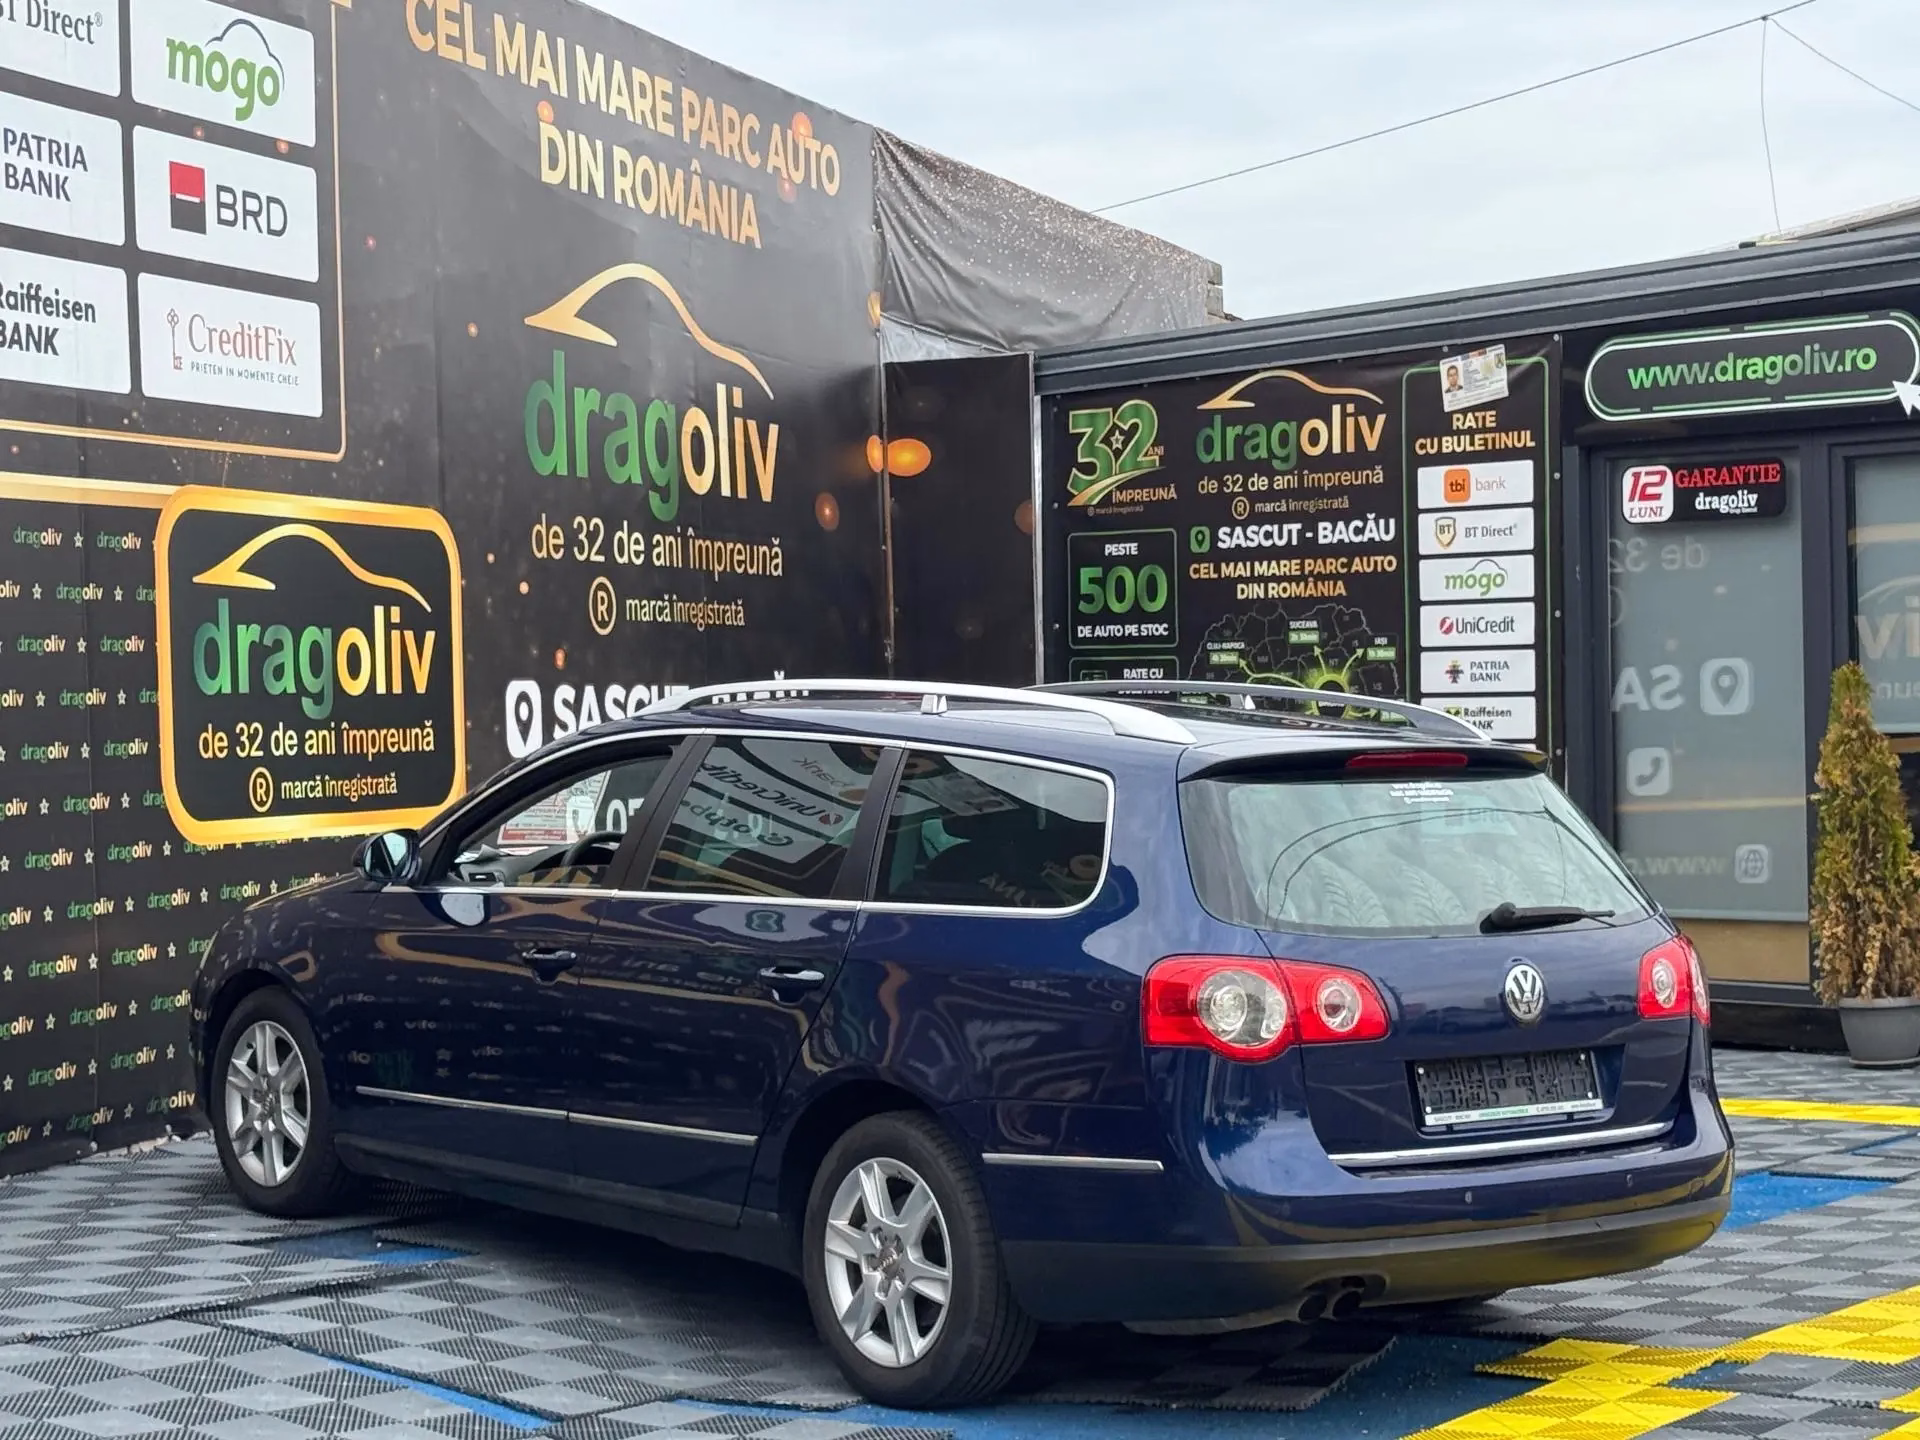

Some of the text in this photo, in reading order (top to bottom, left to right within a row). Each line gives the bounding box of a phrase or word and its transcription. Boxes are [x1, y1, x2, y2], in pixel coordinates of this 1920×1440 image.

[166, 37, 280, 121] mogo
[405, 0, 841, 197] CEL MAI MARE PARC AUTO
[3, 126, 88, 172] PATRIA
[5, 161, 71, 202] BANK
[538, 120, 763, 250] DIN ROMÂNIA
[216, 184, 288, 238] BRD
[188, 313, 297, 366] CreditFix
[191, 361, 299, 386] PRIETEN IN MOMENTE CHEIE
[1627, 343, 1877, 390] www.dragoliv.ro
[1452, 410, 1496, 430] RATE
[524, 350, 780, 522] dragoliv
[1066, 398, 1159, 496] 32
[1195, 403, 1387, 471] dragoliv
[1414, 430, 1536, 455] CU BULETINUL
[1198, 465, 1384, 494] de 32 de ani împreună
[1449, 476, 1507, 492] tbi bank
[1628, 470, 1667, 503] 12
[1675, 463, 1781, 488] GARANTIE
[1255, 499, 1287, 513] marcă
[1288, 495, 1349, 513] înregistrată
[1629, 506, 1663, 519] LUNI
[1695, 489, 1758, 514] dragoliv
[13, 526, 142, 552] dragoliv dragoliv
[1217, 522, 1302, 549] SASCUT
[1318, 512, 1396, 544] BACĂU
[1464, 526, 1479, 538] BT
[531, 513, 783, 582] de 32 de ani împreună
[1104, 542, 1139, 556] PESTE
[1189, 555, 1397, 579] CEL MAI MARE PARC AUTO
[56, 582, 104, 604] dragoliv
[1078, 564, 1168, 614] 500
[1236, 577, 1347, 600] DIN ROMÂNIA
[1444, 572, 1506, 597] mogo
[625, 593, 671, 623] marcă
[672, 589, 746, 632] înregistrată
[1077, 623, 1169, 638] DE AUTO PE STOC
[1455, 616, 1515, 635] UniCredit
[17, 634, 145, 656] dragoliv dragoliv
[193, 598, 436, 720] dragoliv
[1470, 660, 1510, 671] PATRIA
[1123, 668, 1164, 679] RATE CU
[1470, 672, 1502, 682] BANK
[0, 688, 106, 709] oliv dragoliv
[1463, 706, 1512, 718] Raiffeisen
[21, 738, 148, 763] dragoliv dragoliv
[198, 719, 435, 762] de 32 de ani împreună
[280, 774, 323, 800] marcă
[324, 771, 398, 802] înregistrată
[63, 792, 110, 815] dragoliv
[25, 848, 73, 871] dragoliv
[107, 840, 152, 863] dragoliv
[67, 897, 115, 920] dragoliv
[147, 888, 191, 910] dragoliv
[220, 880, 261, 901] dragoliv
[28, 955, 77, 979] dragoliv
[112, 943, 157, 966] dragoliv
[69, 1002, 118, 1026] dragoliv
[28, 1046, 157, 1086] dragoliv dragoliv
